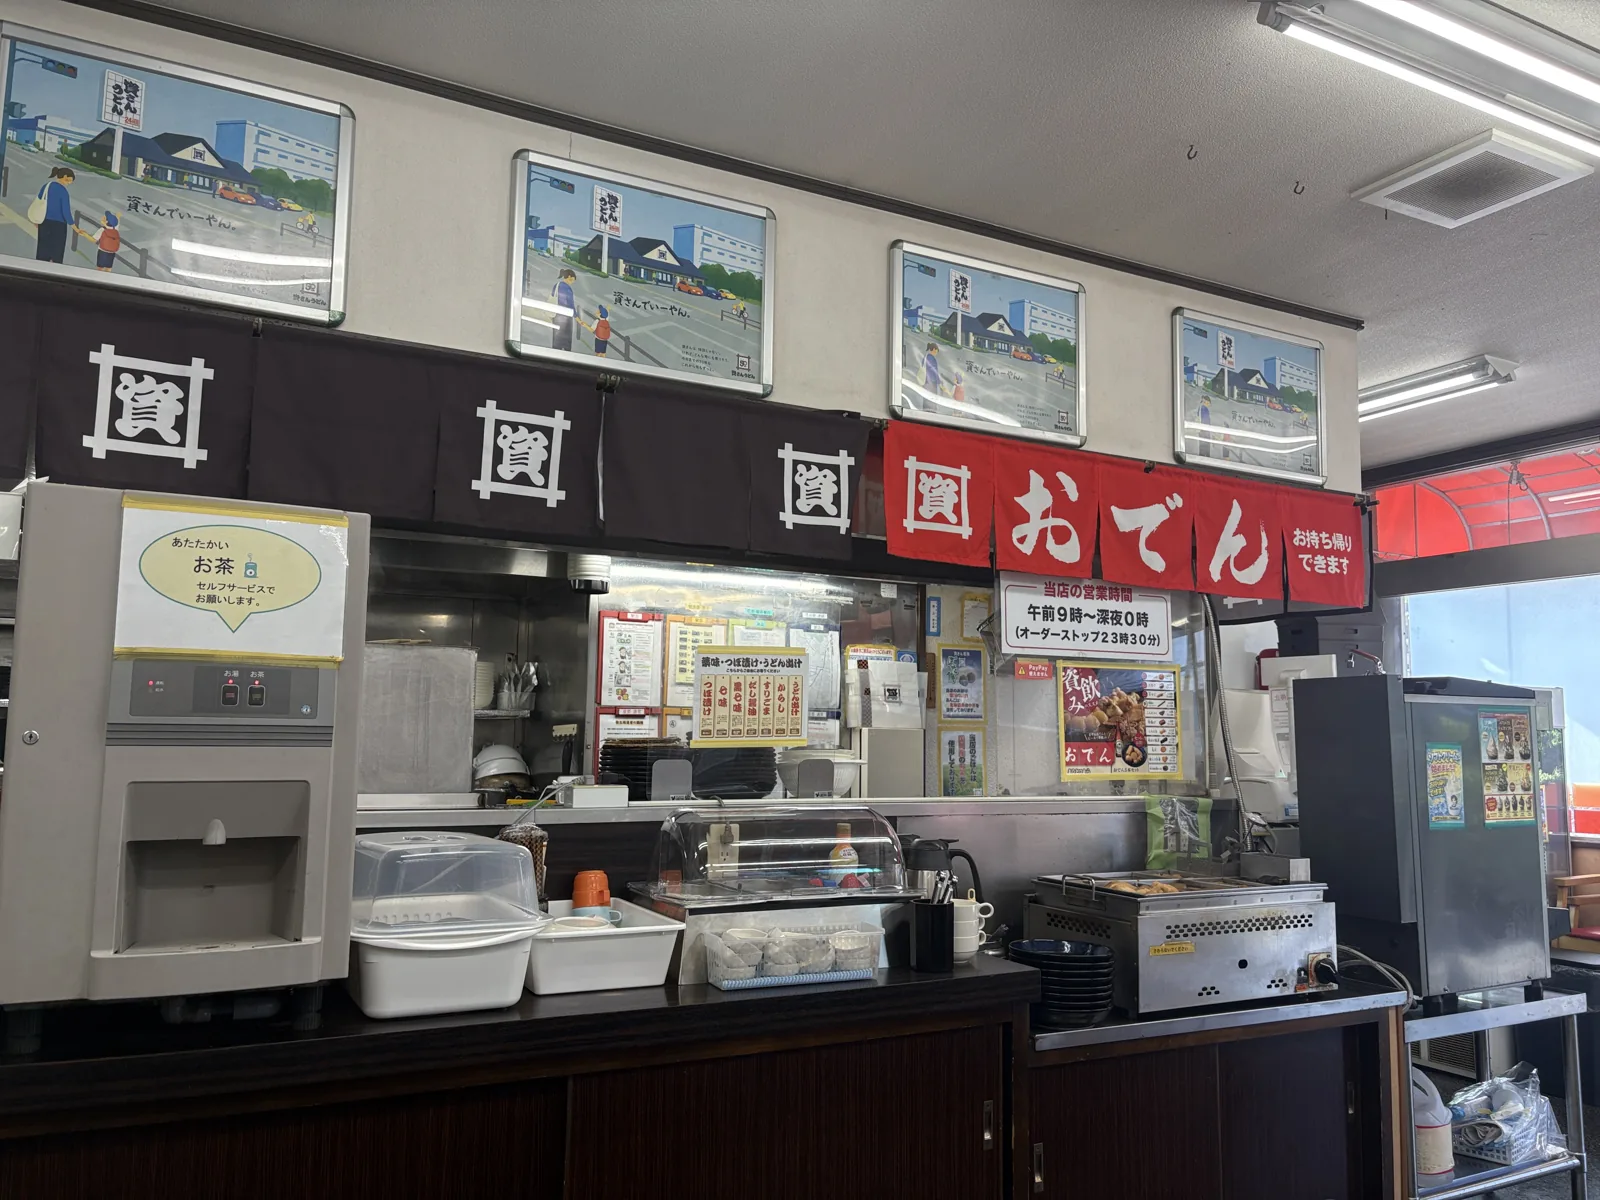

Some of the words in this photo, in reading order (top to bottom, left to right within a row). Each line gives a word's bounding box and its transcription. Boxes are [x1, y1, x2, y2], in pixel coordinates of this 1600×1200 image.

[112, 83, 124, 116] うどん
[126, 195, 237, 231] 資さんでいーやん。
[613, 290, 691, 319] 資さんでいーやん。
[1012, 468, 1269, 585] おでん
[172, 536, 229, 551] あたたかい
[1292, 527, 1352, 553] お持ち帰り
[193, 555, 235, 576] お茶
[1298, 552, 1350, 576] できます
[195, 593, 261, 608] お願いします。
[196, 581, 276, 596] セルフサービスで
[1043, 580, 1133, 603] 当店の営業時間
[762, 680, 771, 716] すりごま
[777, 683, 786, 714] からし
[1065, 747, 1112, 763] おでん
